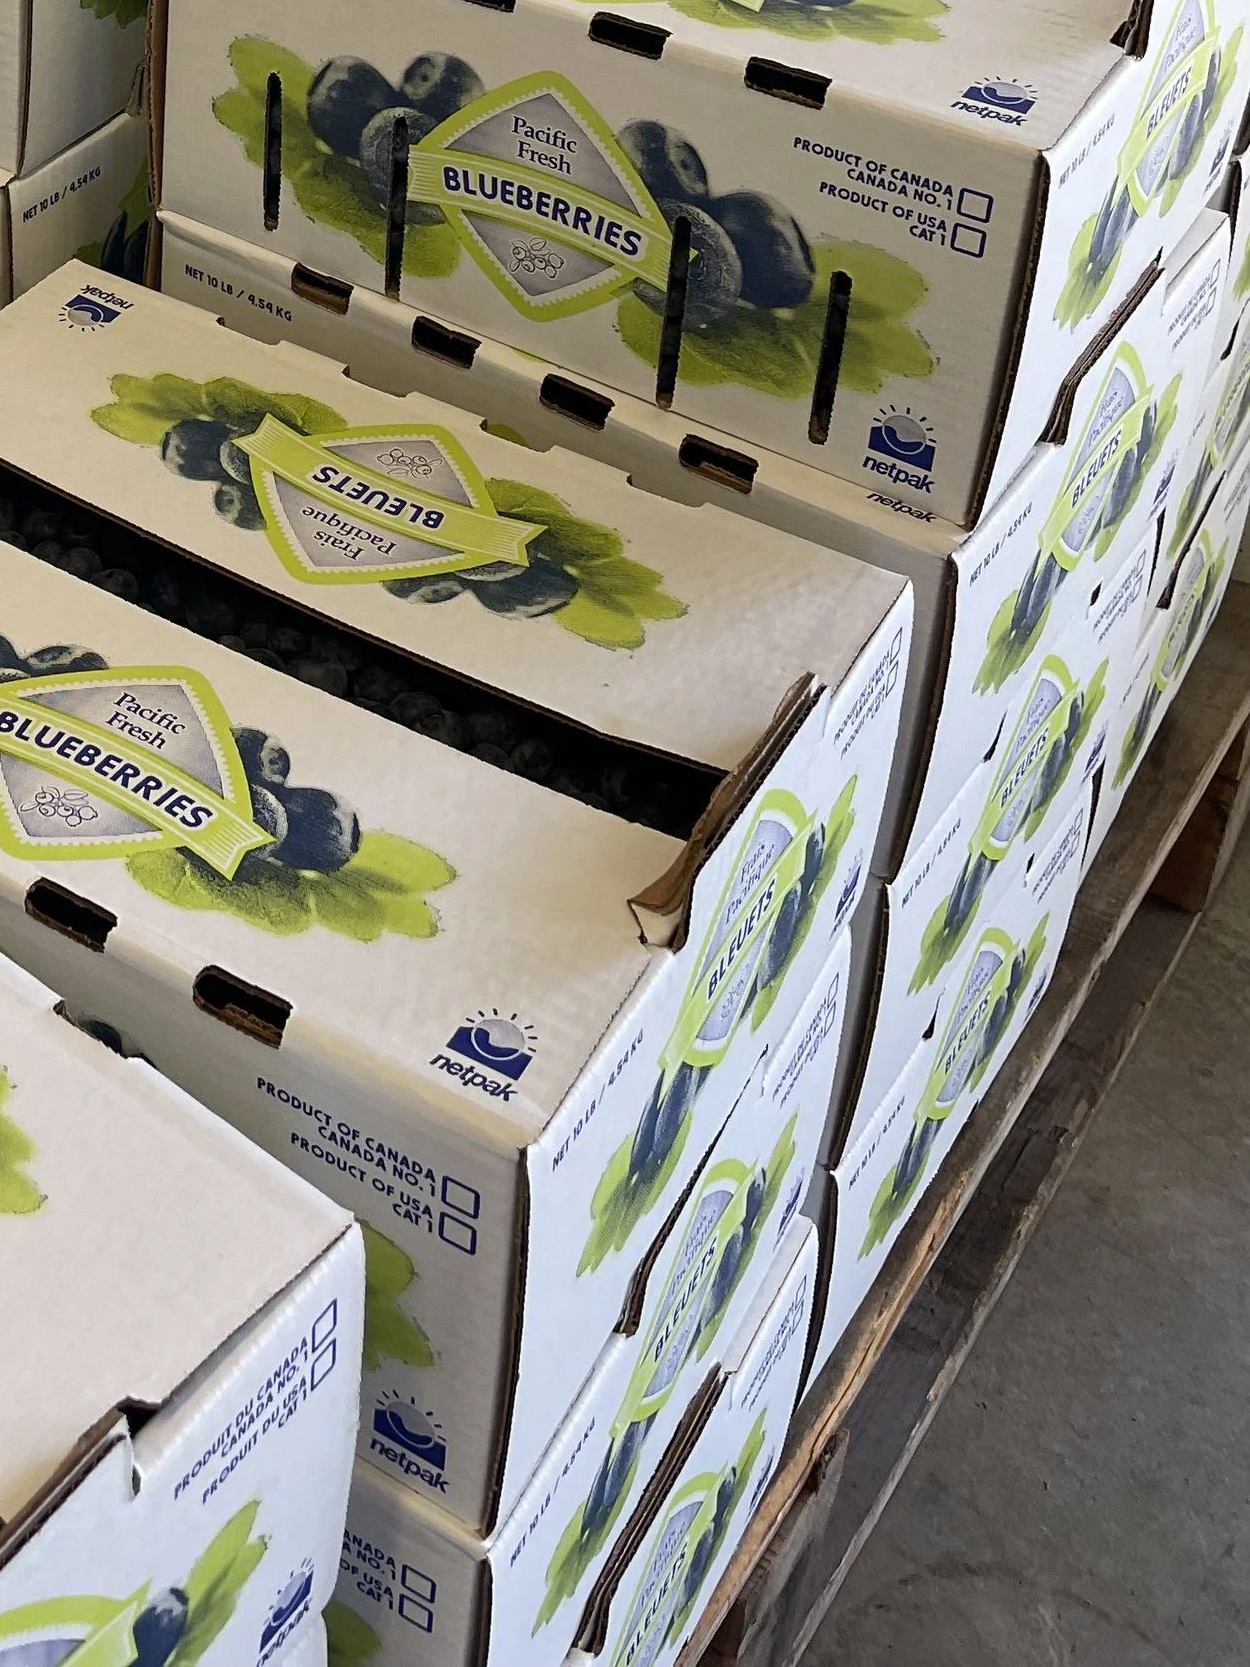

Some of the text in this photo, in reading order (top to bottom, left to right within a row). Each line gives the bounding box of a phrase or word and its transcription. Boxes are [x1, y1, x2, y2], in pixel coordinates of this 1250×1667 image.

[951, 101, 1027, 126] netpak
[1146, 68, 1191, 138] BLEUETS
[512, 116, 576, 158] Pacific
[518, 140, 576, 174] Fresh
[794, 137, 953, 197] PRODUCT OF CANADA
[847, 169, 908, 197] CANADA
[913, 189, 941, 207] NO.
[444, 167, 642, 256] BLUEBERRIES
[820, 182, 946, 232] PRODUCT OF USA
[910, 225, 936, 241] CAT
[81, 285, 134, 309] netpak
[312, 460, 444, 528] BLEUETS
[863, 456, 935, 493] netpak
[302, 507, 396, 560] Pacifique
[314, 522, 364, 560] Frais
[106, 709, 165, 749] Fresh
[114, 693, 185, 737] Pacific
[1001, 727, 1048, 808] BLEUETS
[704, 879, 776, 1004] BLEUETS
[429, 1054, 517, 1101] netpak
[258, 1078, 435, 1182] PRODUCT OF CANADA
[291, 1132, 432, 1219] PRODUCT OF USA
[318, 1126, 386, 1171] CANADA
[393, 1165, 423, 1190] NO.
[393, 1204, 421, 1225] CAT
[655, 1244, 716, 1362] BLEUETS
[371, 1437, 449, 1493] netpak
